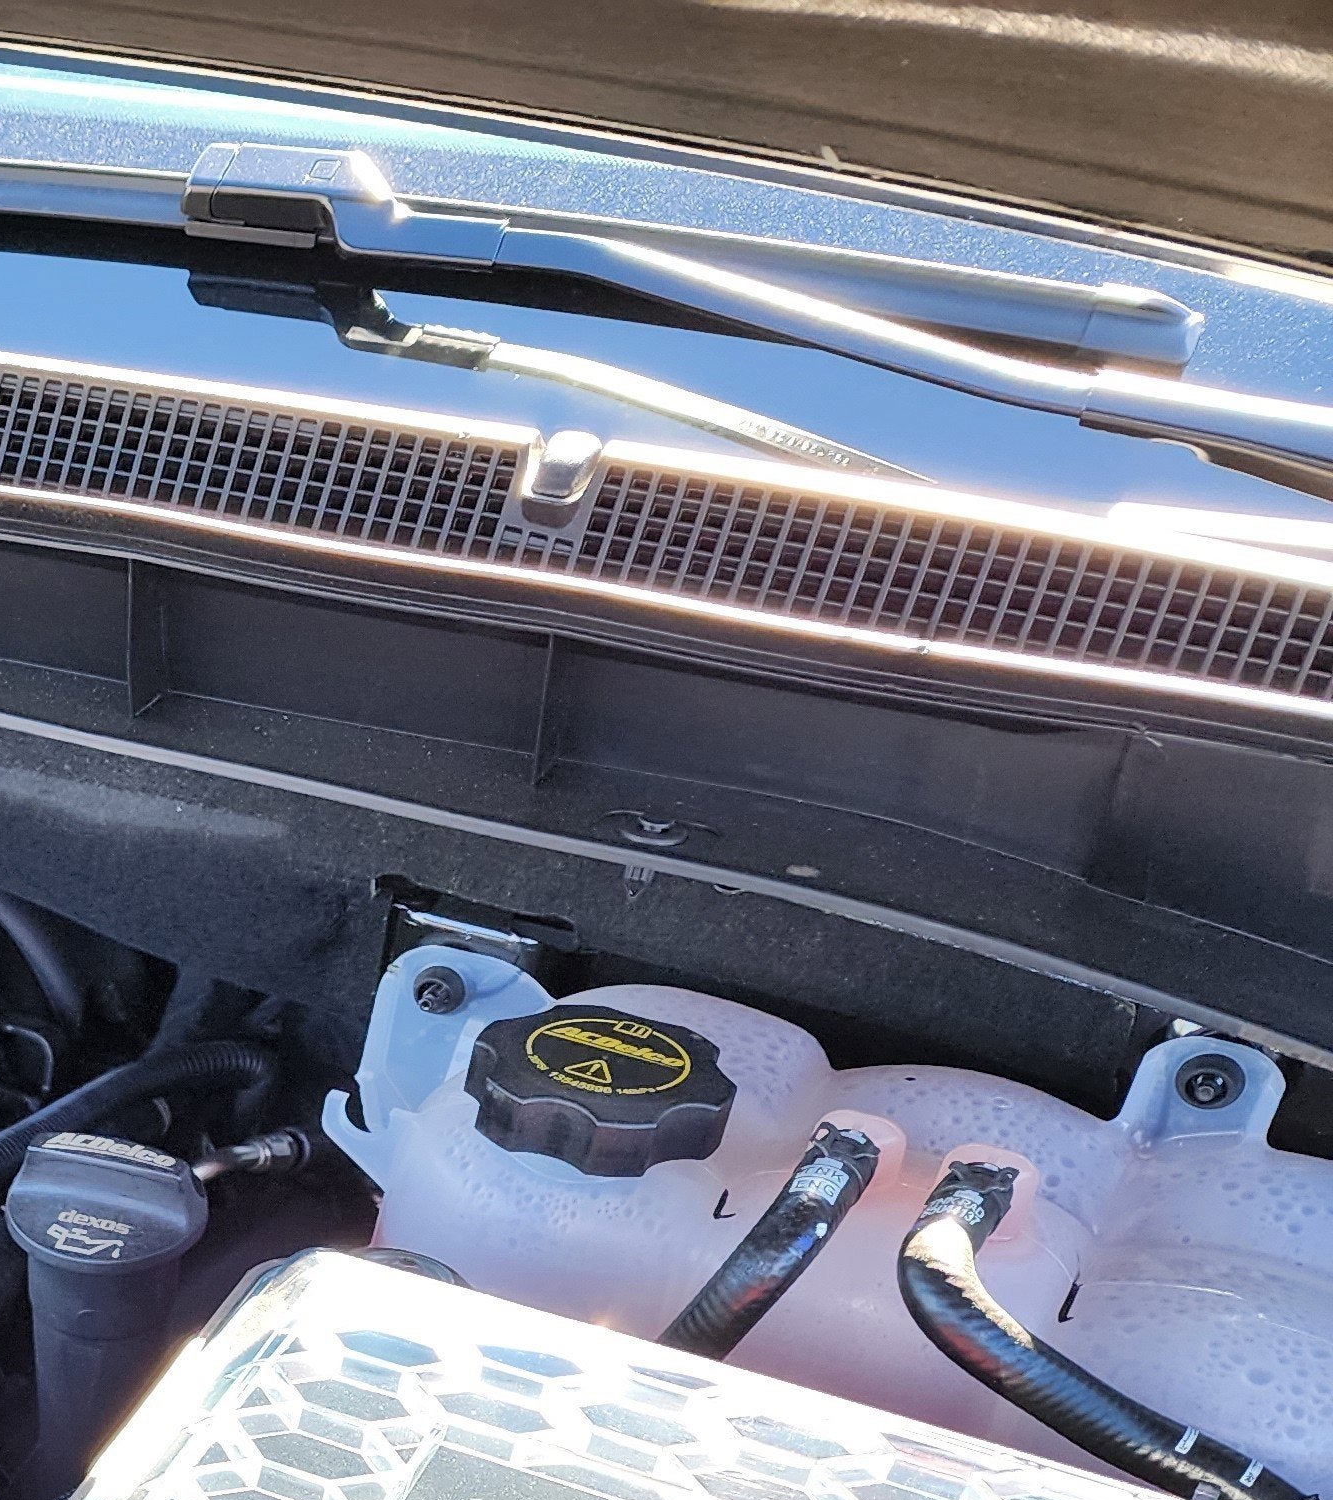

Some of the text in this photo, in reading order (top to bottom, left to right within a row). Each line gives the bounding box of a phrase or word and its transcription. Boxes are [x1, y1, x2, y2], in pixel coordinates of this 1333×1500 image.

[548, 1026, 686, 1068] ACDelco
[42, 1131, 177, 1168] ACDelco
[794, 1179, 836, 1198] ENG
[57, 1209, 132, 1236] dexos
